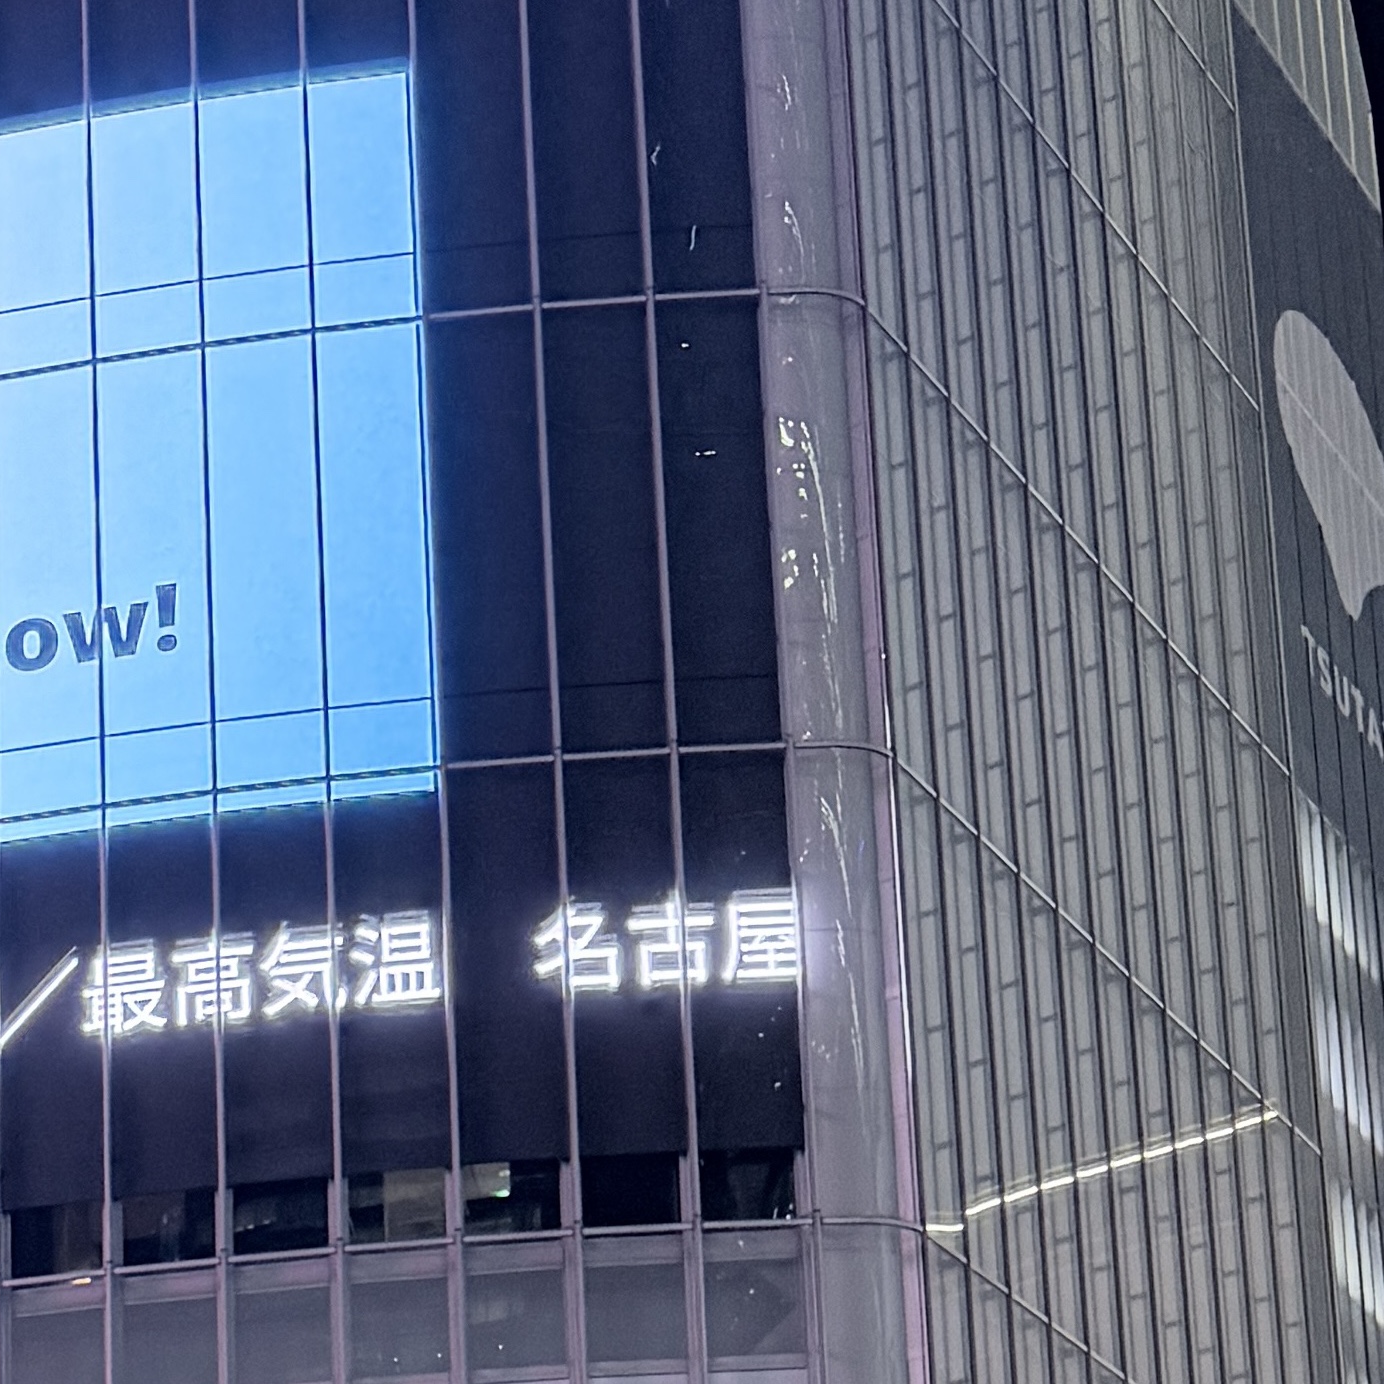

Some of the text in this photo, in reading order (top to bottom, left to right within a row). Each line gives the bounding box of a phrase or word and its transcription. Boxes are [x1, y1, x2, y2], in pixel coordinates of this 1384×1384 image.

[1300, 624, 1384, 760] TSUTA
[533, 888, 798, 991] 名古屋
